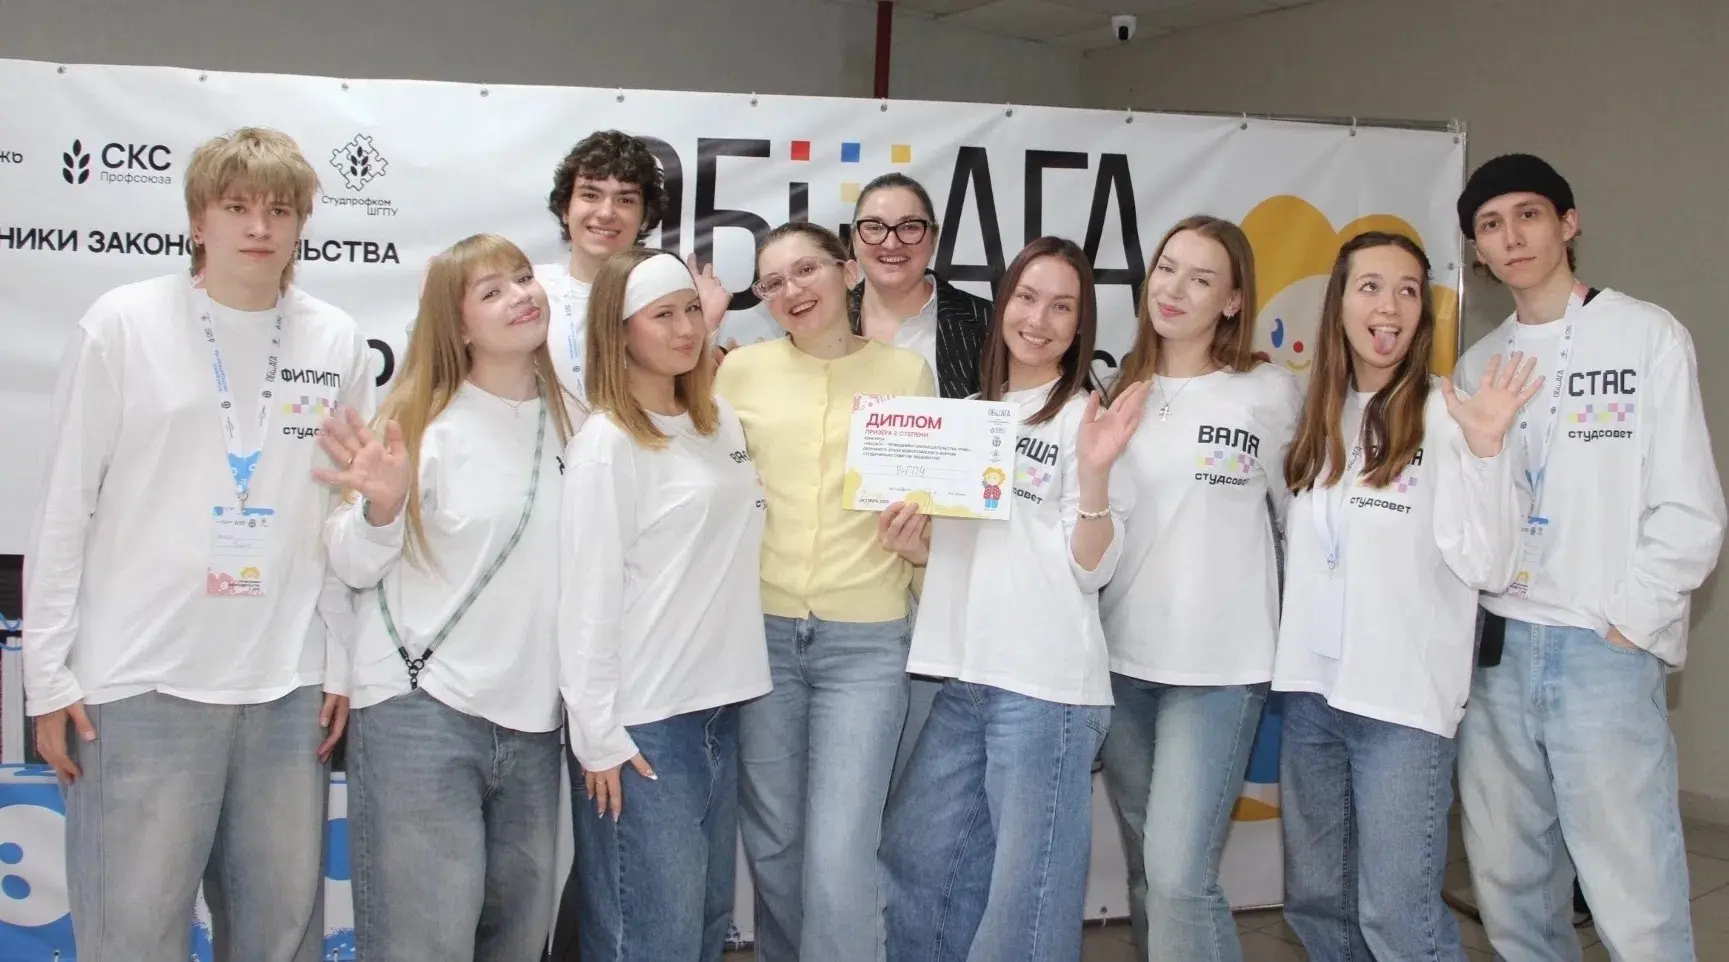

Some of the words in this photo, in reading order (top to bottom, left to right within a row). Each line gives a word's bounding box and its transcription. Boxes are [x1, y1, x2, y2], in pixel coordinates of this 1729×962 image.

[101, 143, 172, 171] СКС
[100, 171, 172, 185] Профсоюза
[321, 195, 391, 206] Студпрофком
[367, 206, 399, 217] ШГПУ
[281, 368, 341, 388] ФИЛИПП
[1568, 369, 1637, 397] СТАС
[866, 413, 942, 430] ДИПЛОМ
[1198, 425, 1260, 458] ВАЛЯ
[1568, 429, 1633, 442] студсовет
[1015, 436, 1060, 466] АША
[1350, 497, 1412, 514] студсовет
